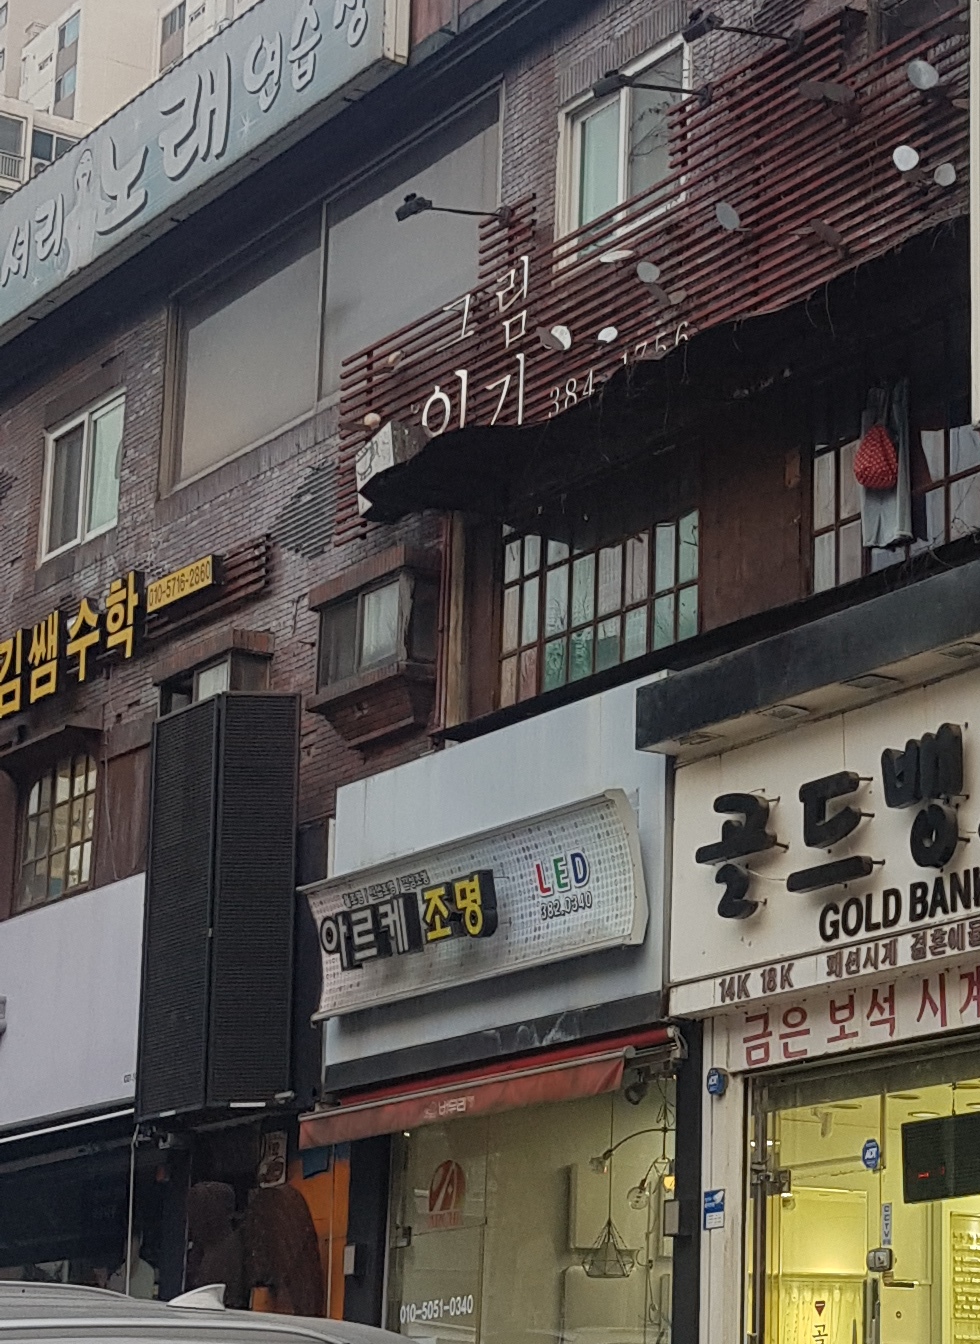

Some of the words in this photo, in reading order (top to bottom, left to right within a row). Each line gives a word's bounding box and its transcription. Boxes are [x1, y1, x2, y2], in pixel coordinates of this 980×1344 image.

[96, 52, 232, 236] 노래
[535, 851, 592, 897] LED
[422, 873, 485, 943] 조명
[818, 886, 901, 943] GOLD
[718, 972, 752, 1004] 14K
[760, 962, 795, 994] 18K
[825, 937, 899, 979] 패션시계
[743, 1006, 811, 1068] 금은
[826, 983, 896, 1045] 보석
[399, 1294, 474, 1325] 010-5051-0340
